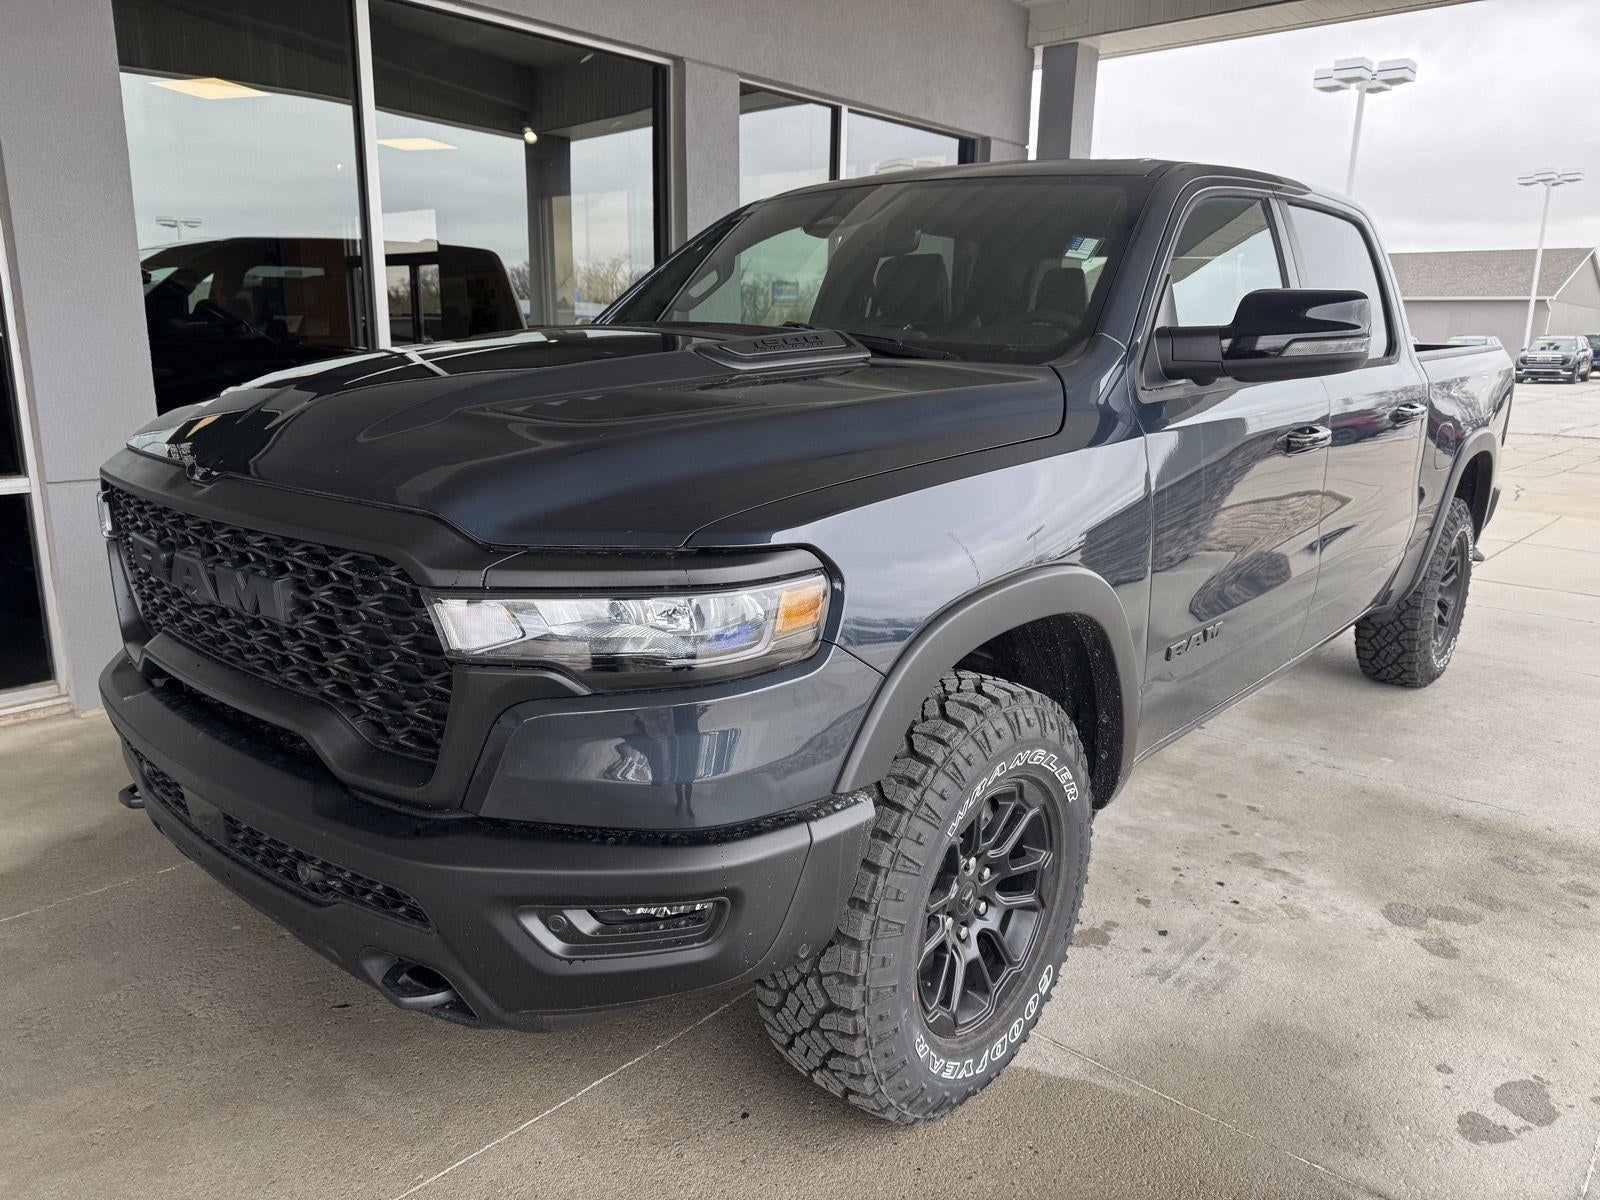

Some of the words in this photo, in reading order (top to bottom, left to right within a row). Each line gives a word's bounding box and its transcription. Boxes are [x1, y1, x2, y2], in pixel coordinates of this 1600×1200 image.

[129, 532, 297, 624] RAM
[1164, 620, 1224, 662] RAM
[947, 749, 1079, 837] WRANGLER
[914, 964, 1054, 1080] GOODYEAR
